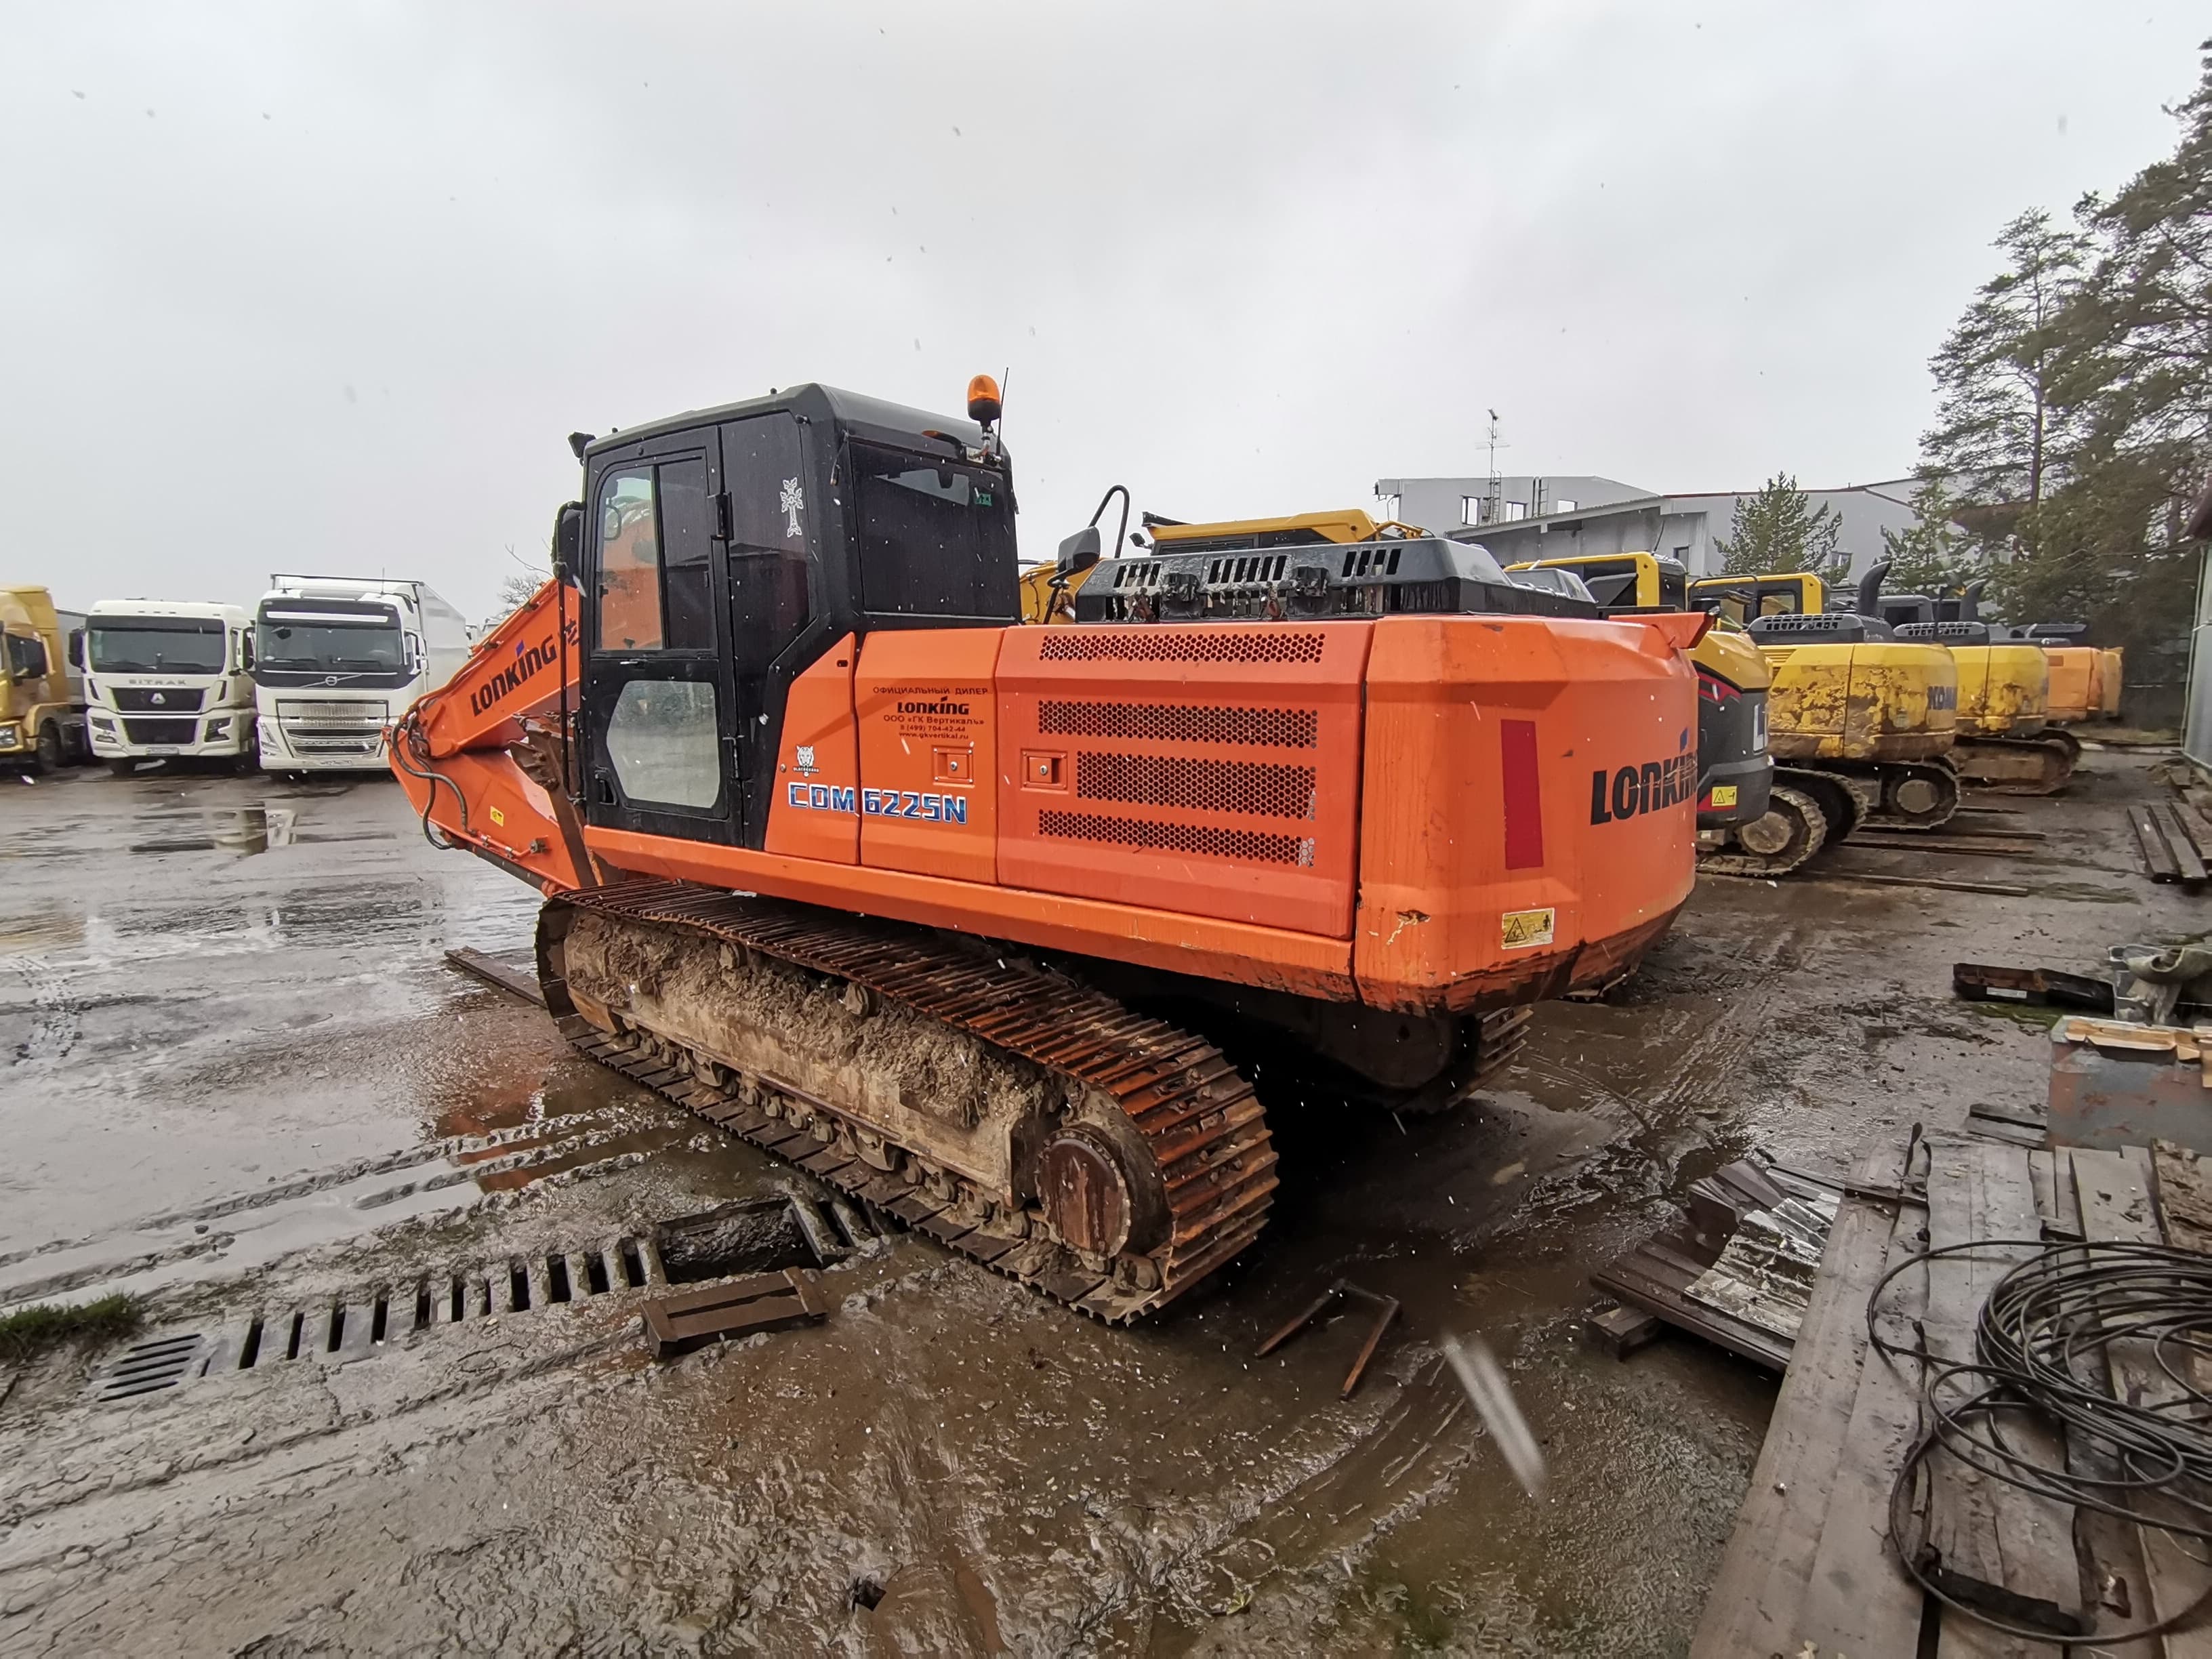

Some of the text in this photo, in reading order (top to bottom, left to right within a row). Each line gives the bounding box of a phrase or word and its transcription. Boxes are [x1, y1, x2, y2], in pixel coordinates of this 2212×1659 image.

[470, 634, 557, 716] LONKING
[873, 686, 988, 695] ОФИЦИАЛЬНЫЙ ДИЛЕР
[897, 695, 970, 715] LONKING
